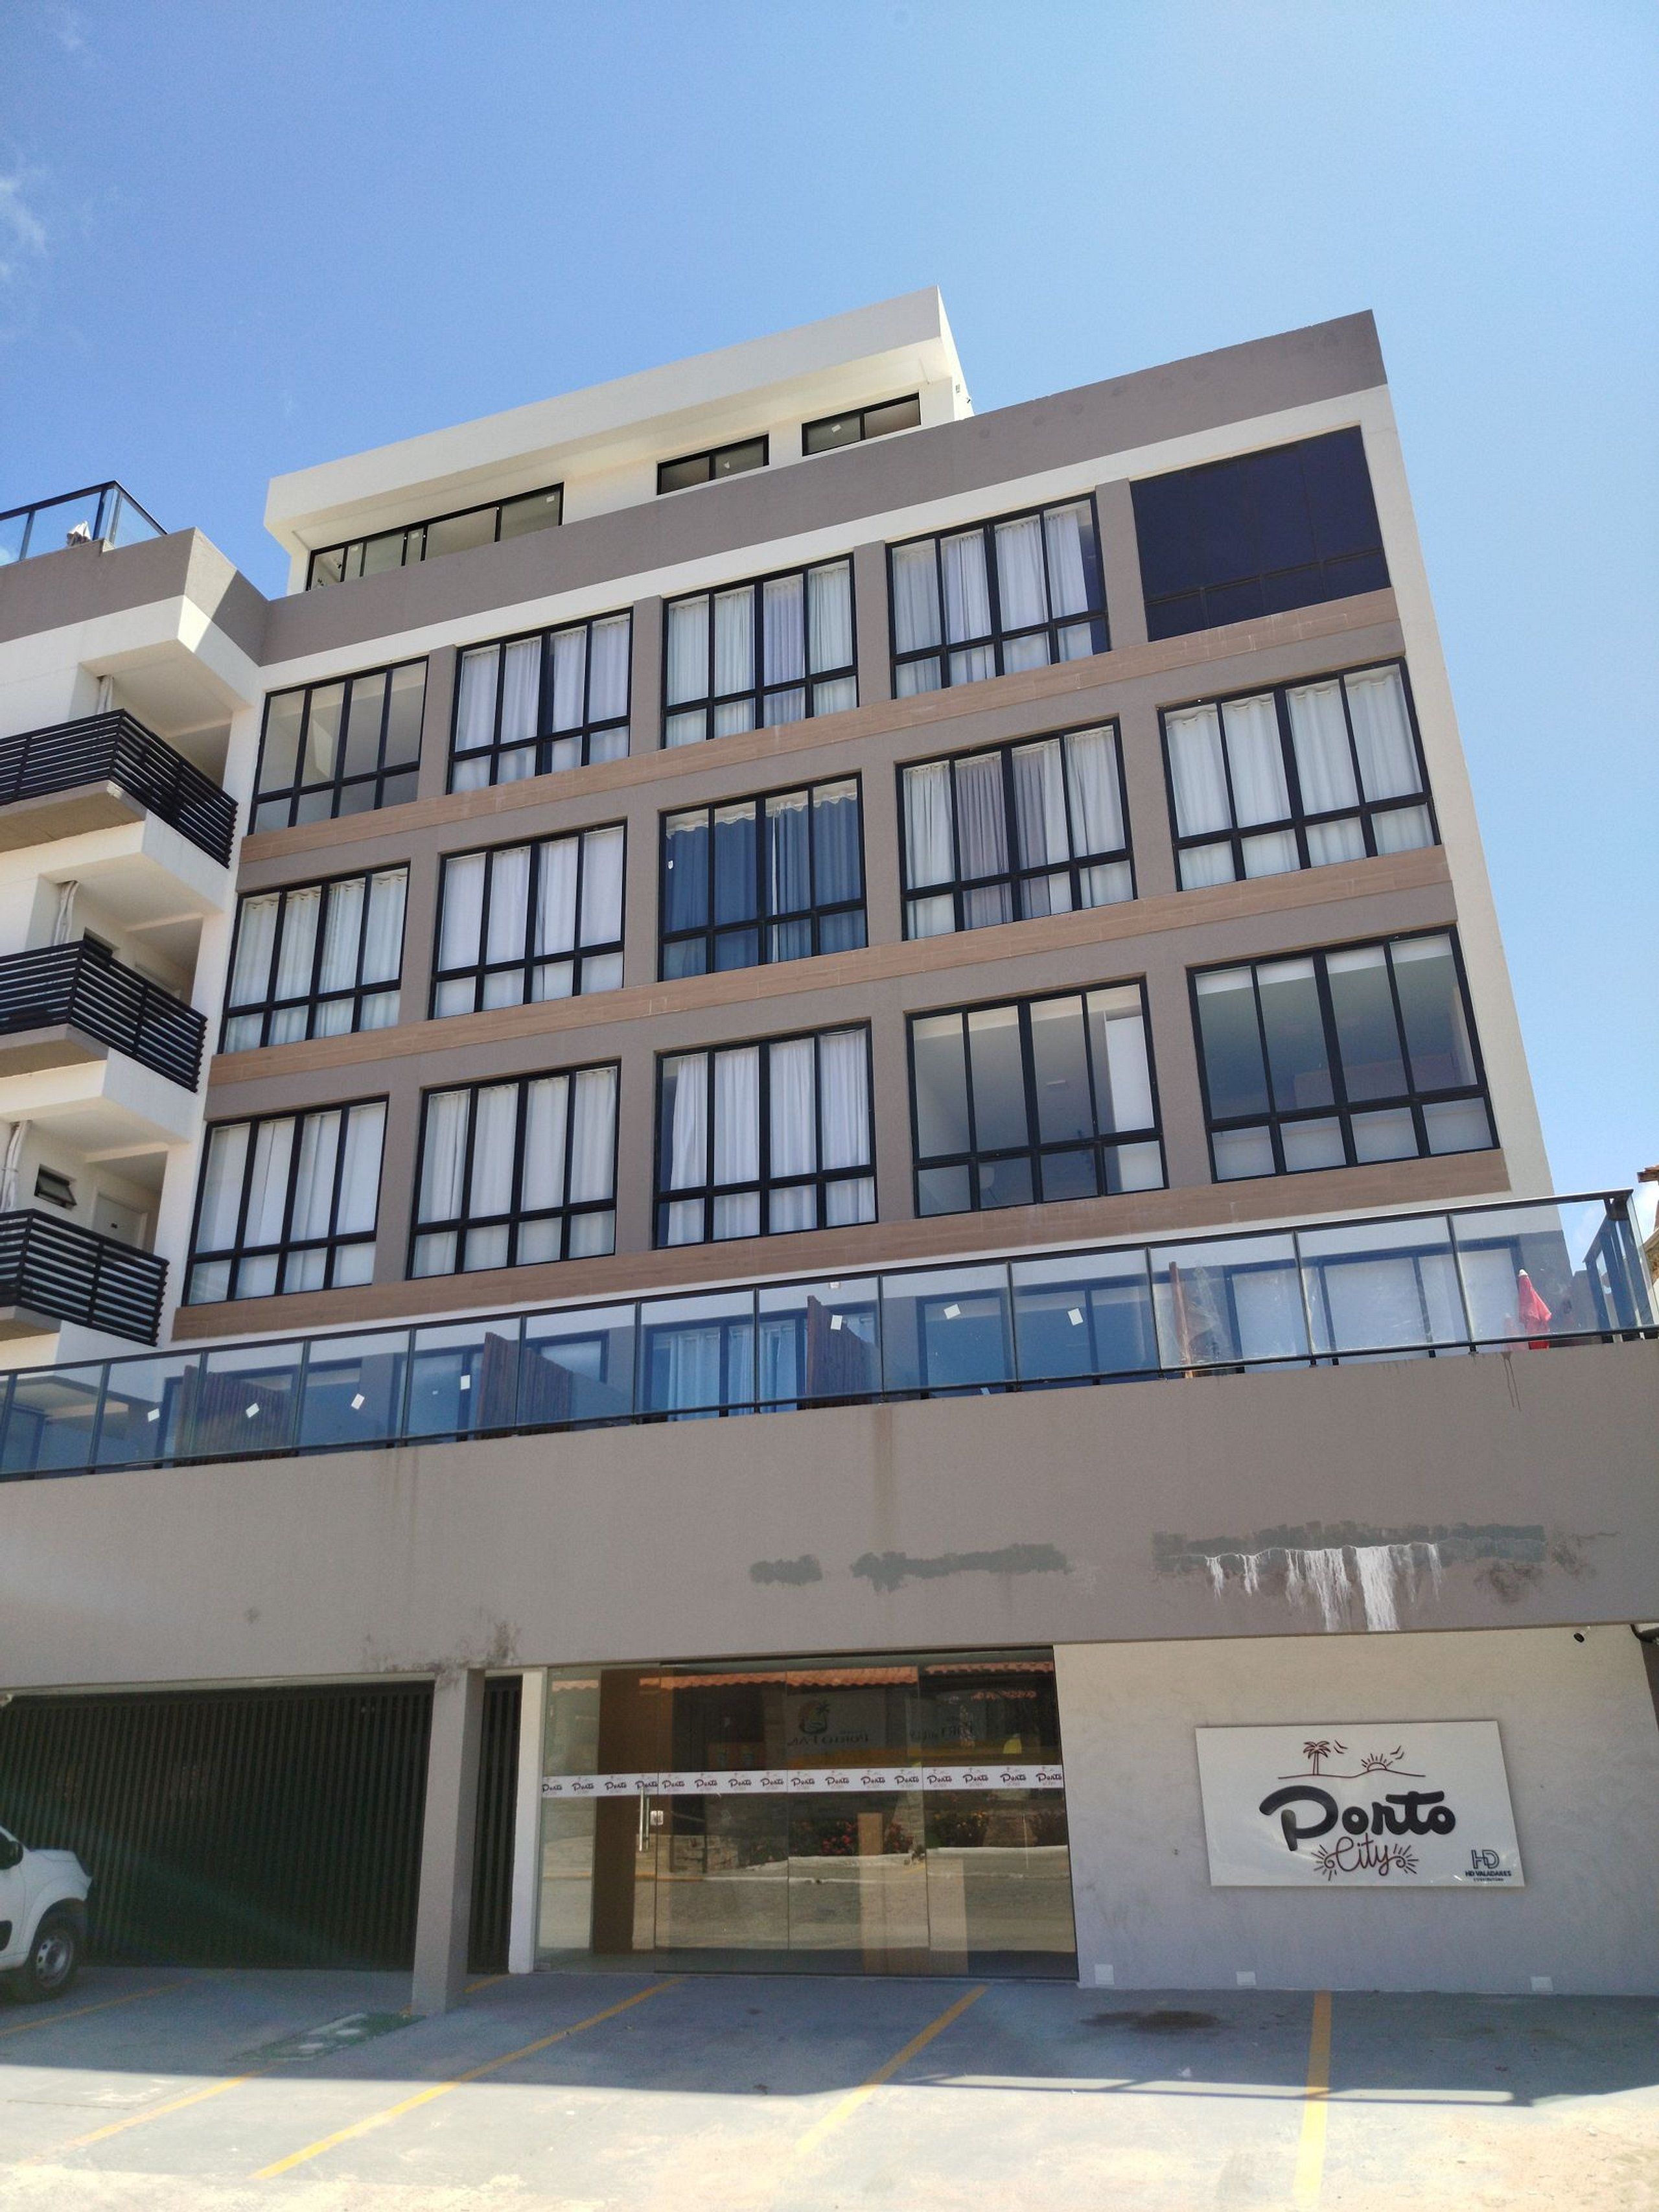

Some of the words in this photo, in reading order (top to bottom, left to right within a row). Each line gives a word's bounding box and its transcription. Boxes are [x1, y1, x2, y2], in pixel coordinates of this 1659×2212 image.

[791, 1777, 815, 1787] Porto
[825, 1776, 850, 1786] Porto
[861, 1775, 886, 1786] Porto
[894, 1775, 920, 1786] Porto
[927, 1775, 952, 1784] Porto
[963, 1773, 988, 1783] Porto
[1000, 1773, 1027, 1783] Porto
[1036, 1773, 1062, 1782] Porto
[1259, 1785, 1456, 1851] Porto
[1324, 1833, 1406, 1876] City
[1471, 1849, 1500, 1869] HD
